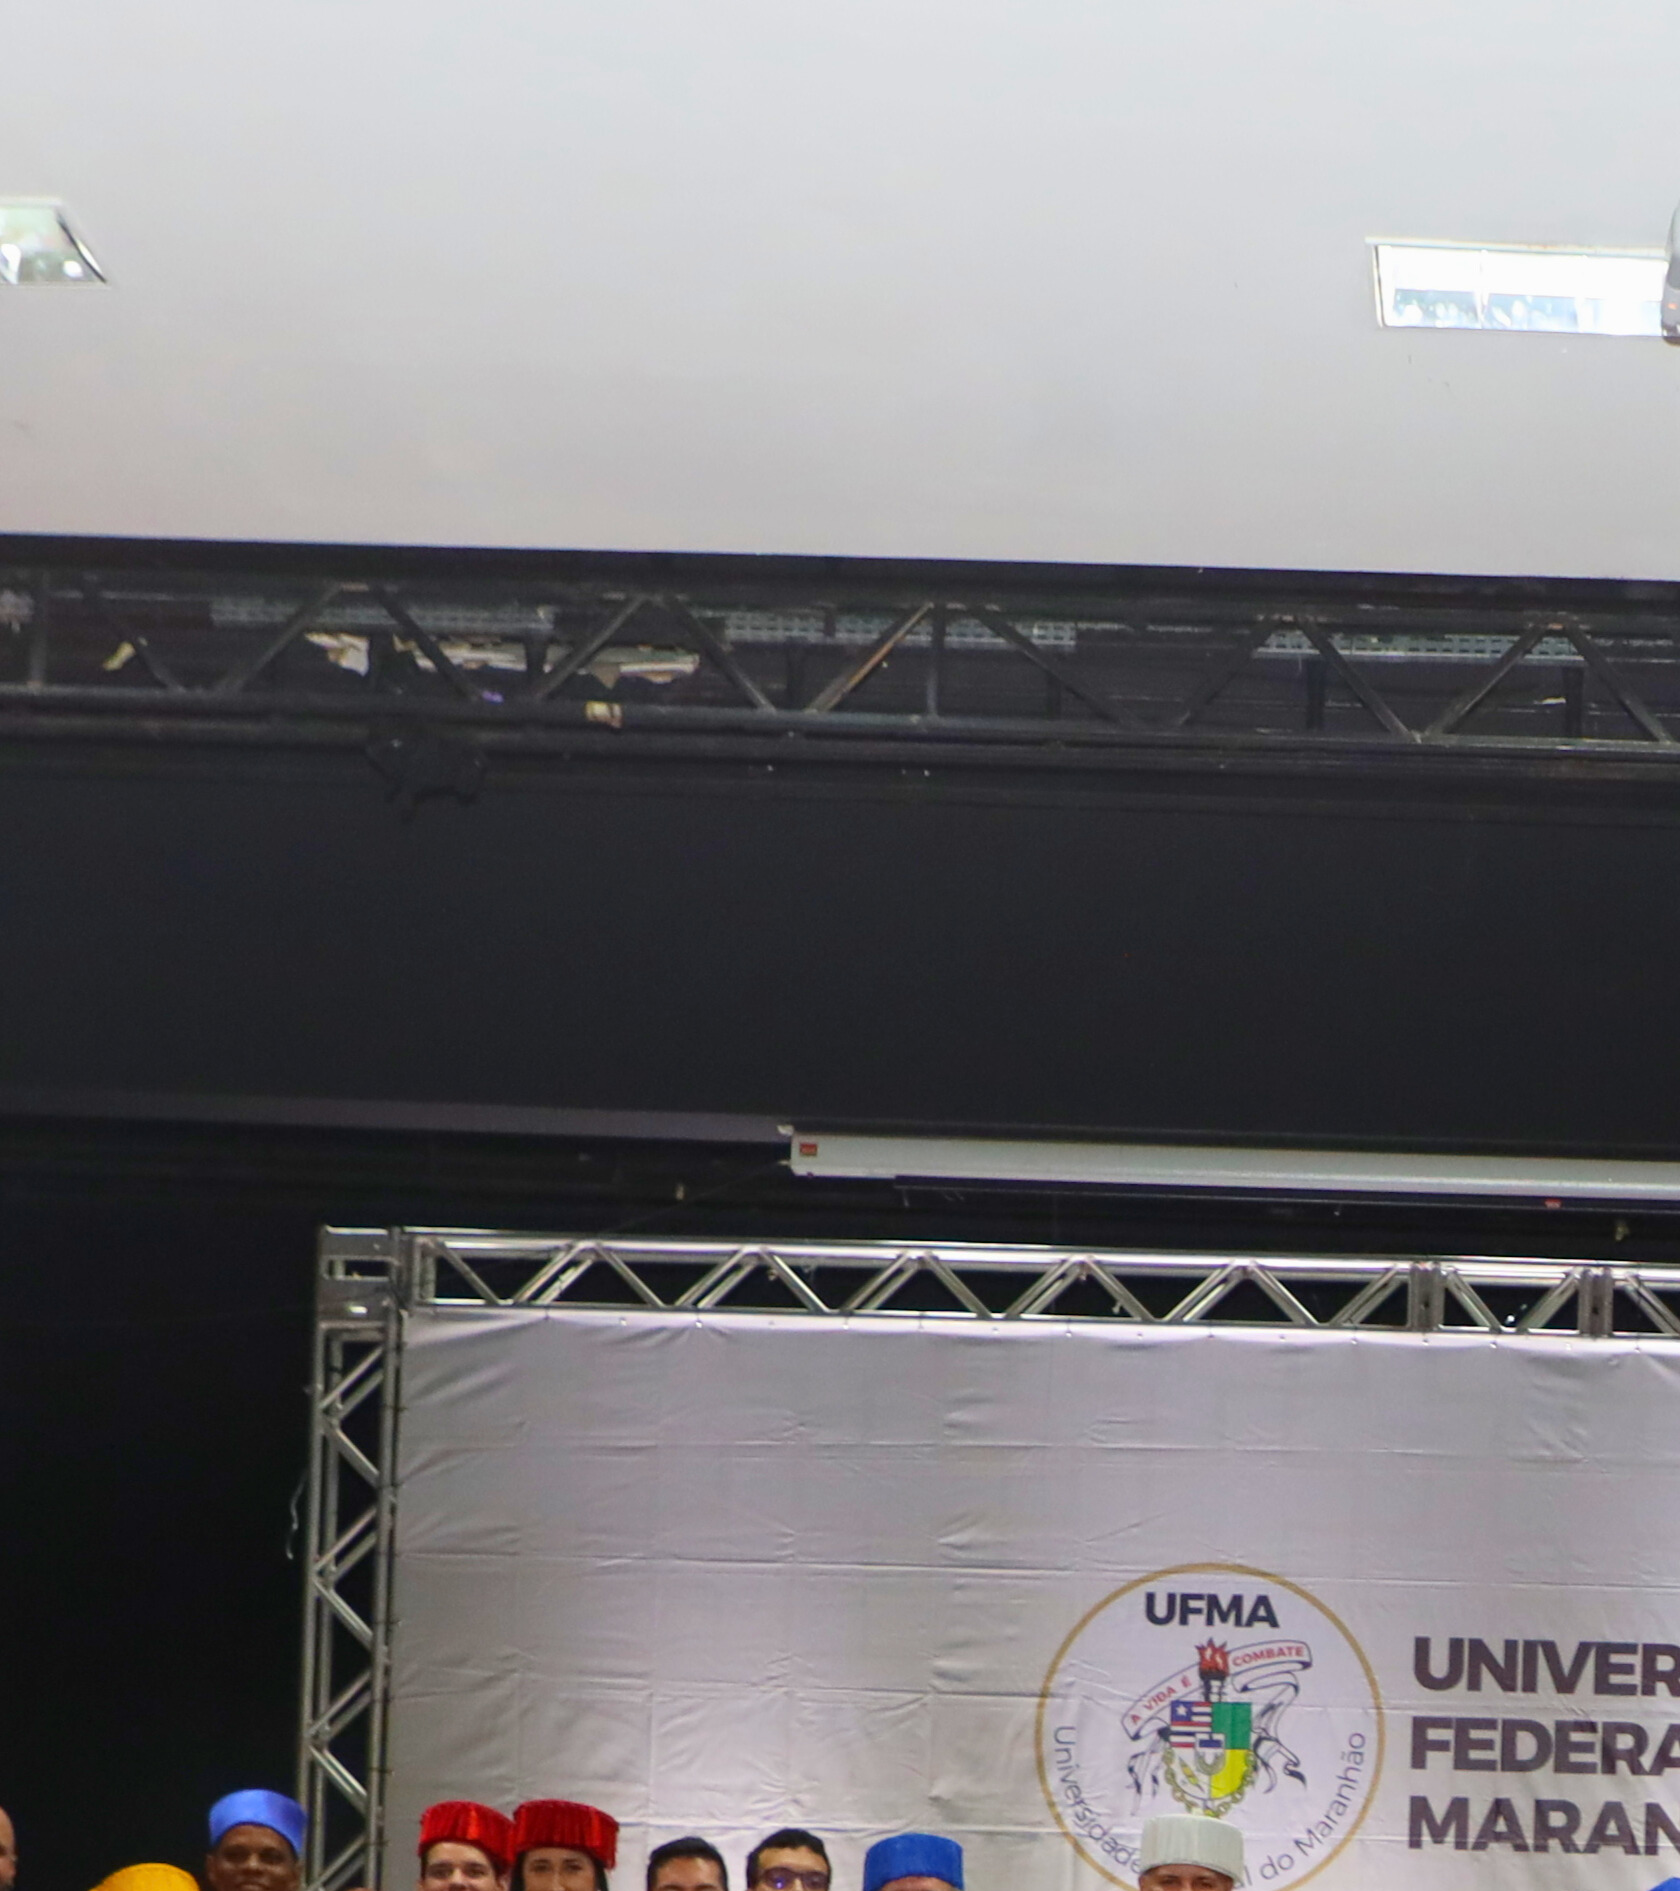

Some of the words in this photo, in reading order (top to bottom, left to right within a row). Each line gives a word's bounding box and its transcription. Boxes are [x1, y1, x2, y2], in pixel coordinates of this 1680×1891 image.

[1144, 1591, 1280, 1628] UFMA
[1143, 1685, 1177, 1711] VIDA
[1232, 1646, 1305, 1667] COMBATE
[1260, 1852, 1295, 1881] do
[1293, 1732, 1366, 1857] Maranhão
